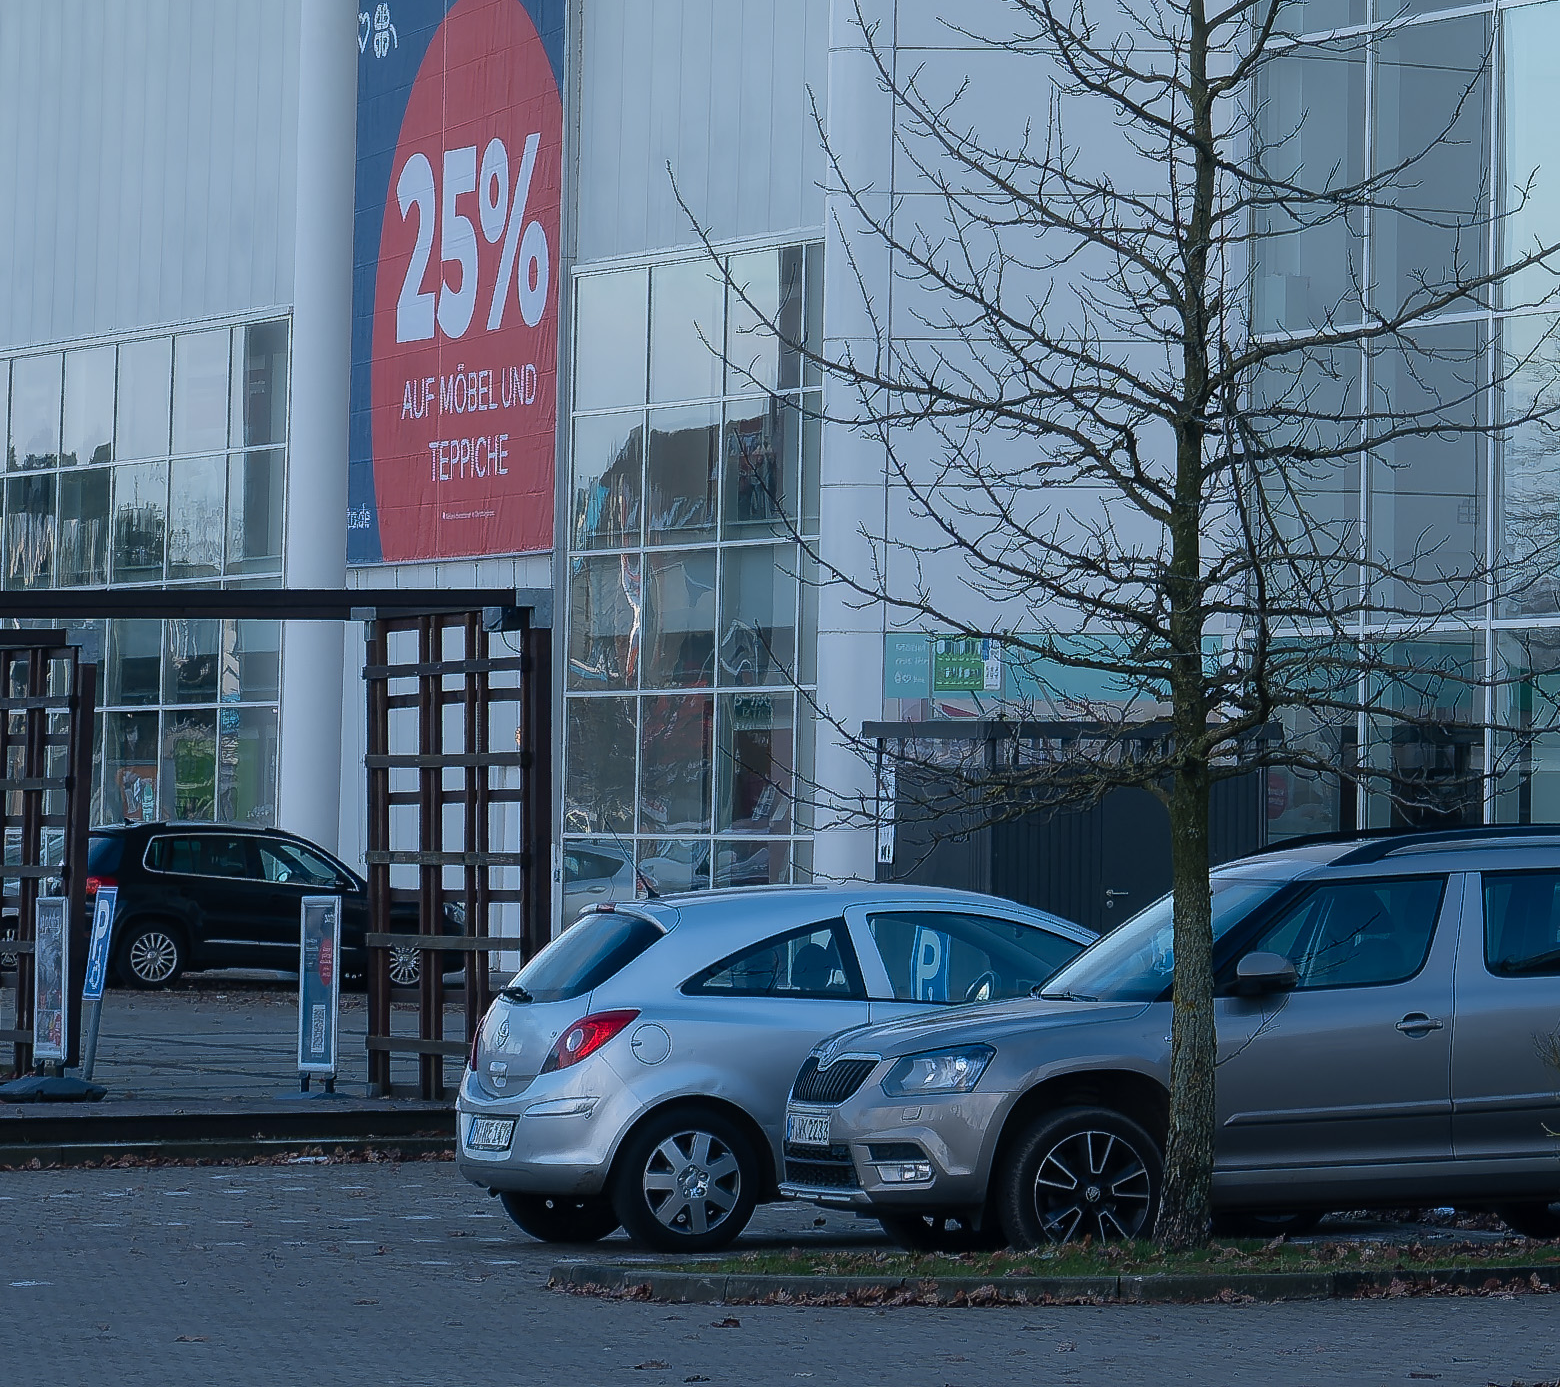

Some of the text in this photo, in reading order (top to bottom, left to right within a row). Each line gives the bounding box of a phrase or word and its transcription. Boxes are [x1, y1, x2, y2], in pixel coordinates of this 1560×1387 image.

[396, 132, 550, 343] 25%
[400, 363, 537, 420] AUF MÖBEL UND
[428, 433, 508, 482] TEPPICHE
